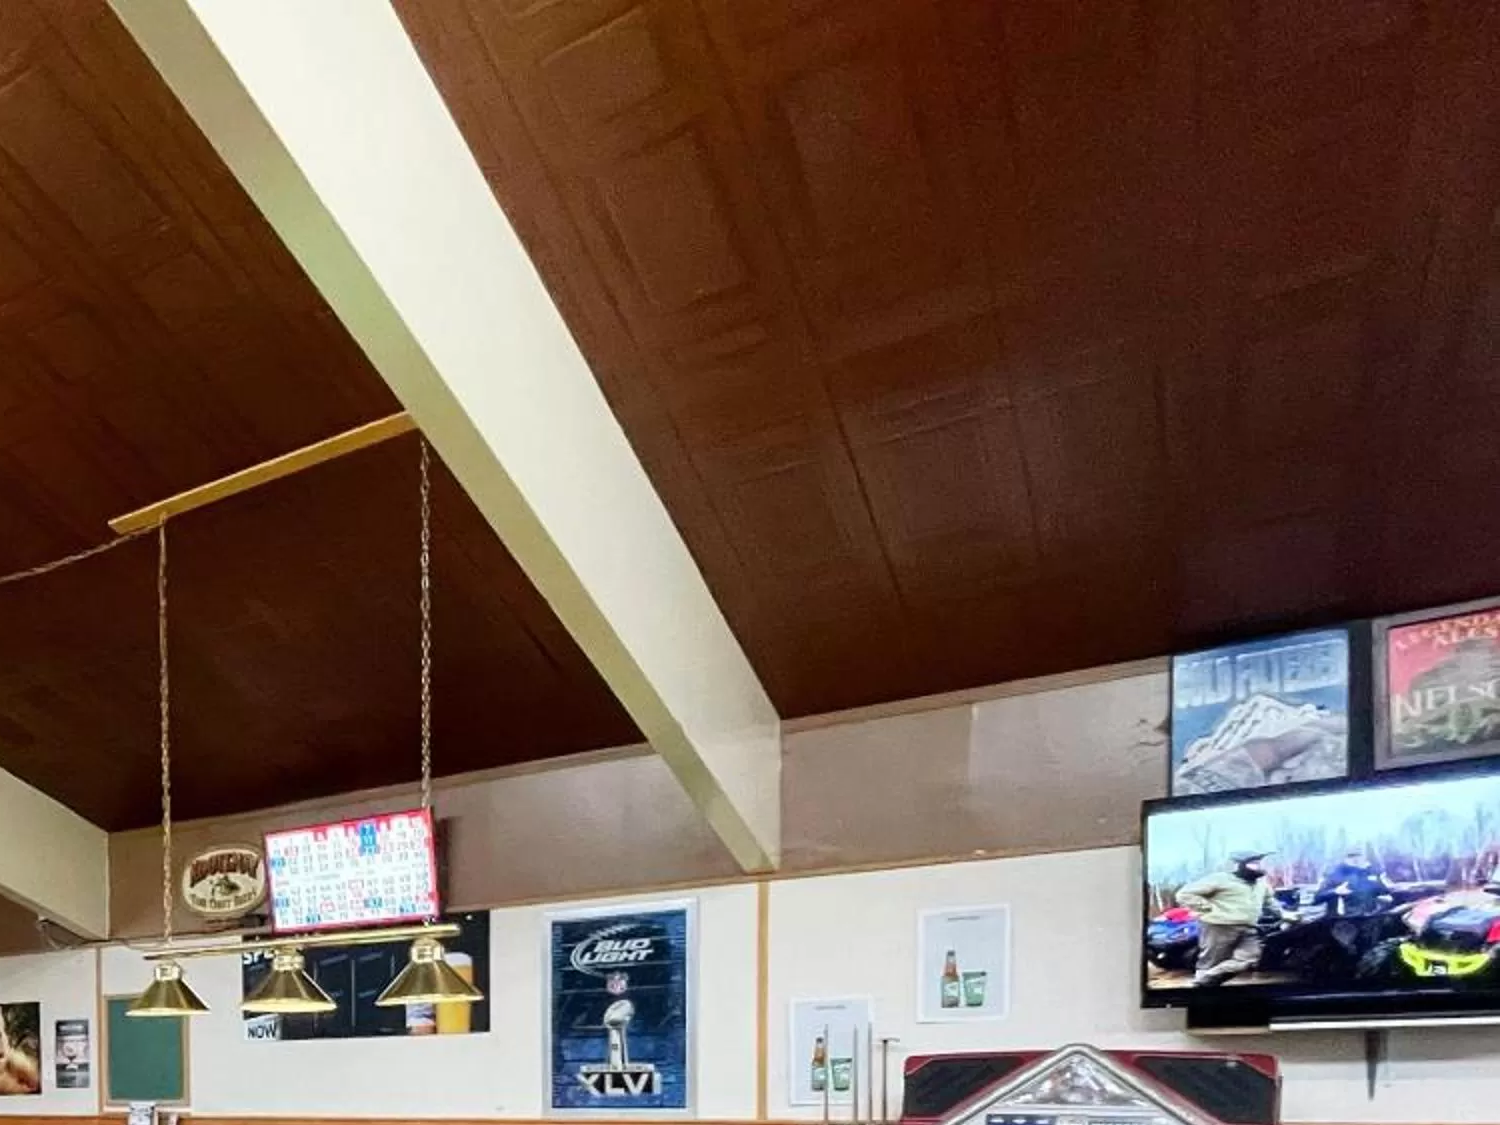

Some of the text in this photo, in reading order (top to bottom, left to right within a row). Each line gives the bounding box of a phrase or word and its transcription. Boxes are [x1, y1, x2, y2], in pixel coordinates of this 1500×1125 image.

[594, 937, 651, 952] BUD
[583, 948, 654, 963] LIGHT
[247, 1020, 277, 1039] NOW
[577, 1071, 662, 1098] XLVI
